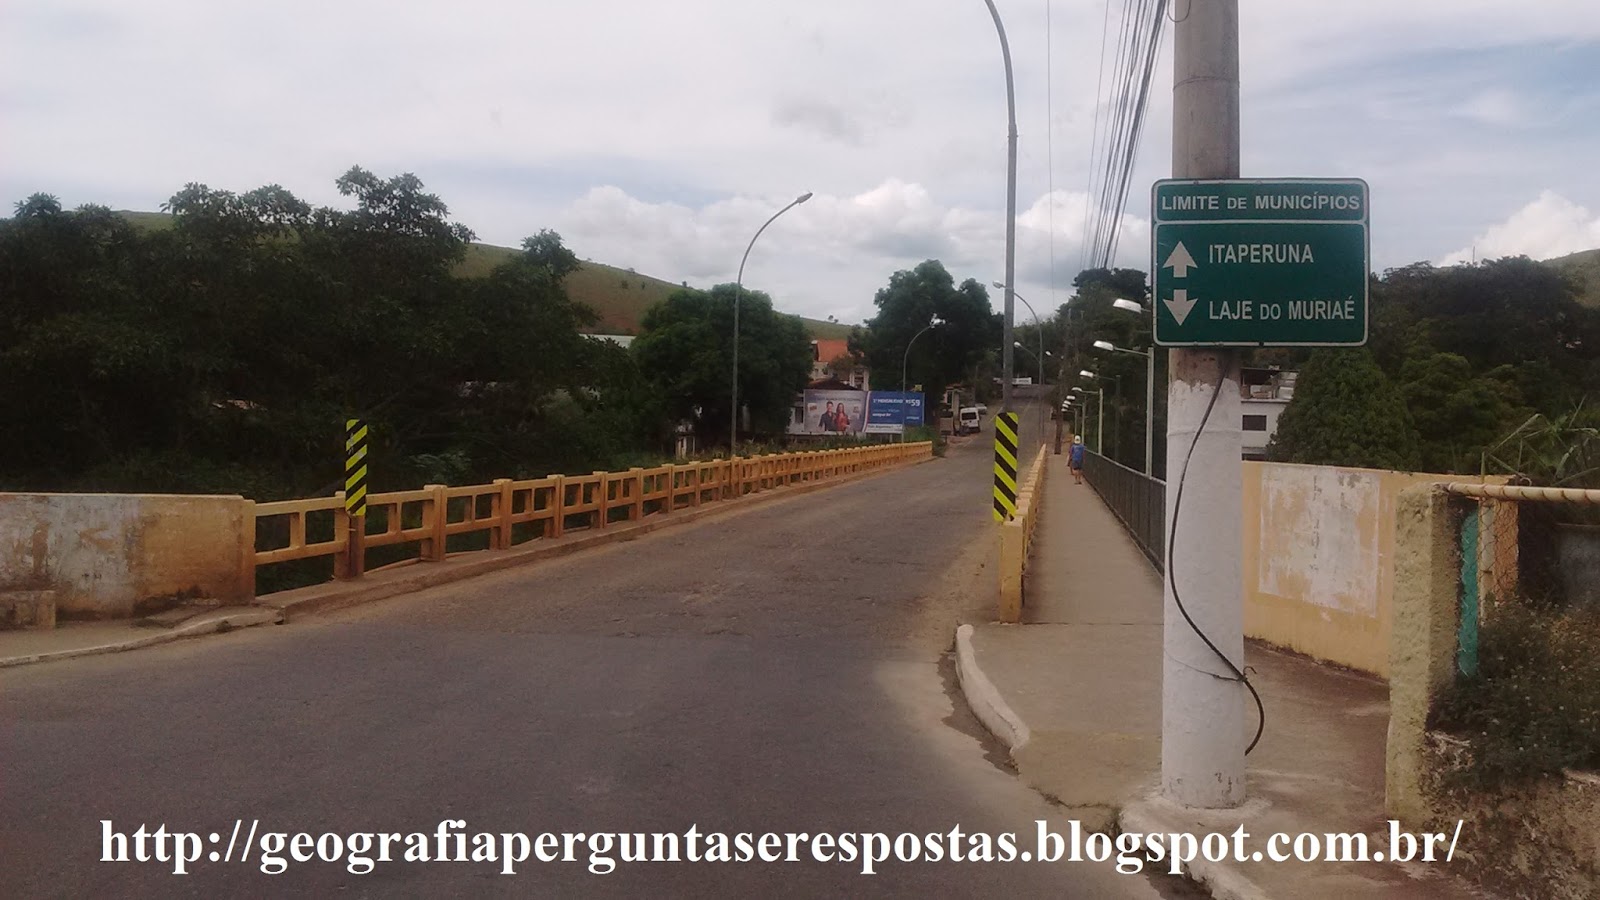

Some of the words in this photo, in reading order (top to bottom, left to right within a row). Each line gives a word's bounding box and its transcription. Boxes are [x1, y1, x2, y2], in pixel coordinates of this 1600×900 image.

[1162, 195, 1219, 210] LIMITE
[1227, 197, 1247, 210] DE
[1255, 192, 1360, 210] MUNICÍPIOS
[1209, 244, 1314, 264] ITAPERUNA
[1209, 300, 1253, 320] LAJE
[1260, 303, 1281, 320] DO
[1288, 295, 1355, 320] MURIAÉ
